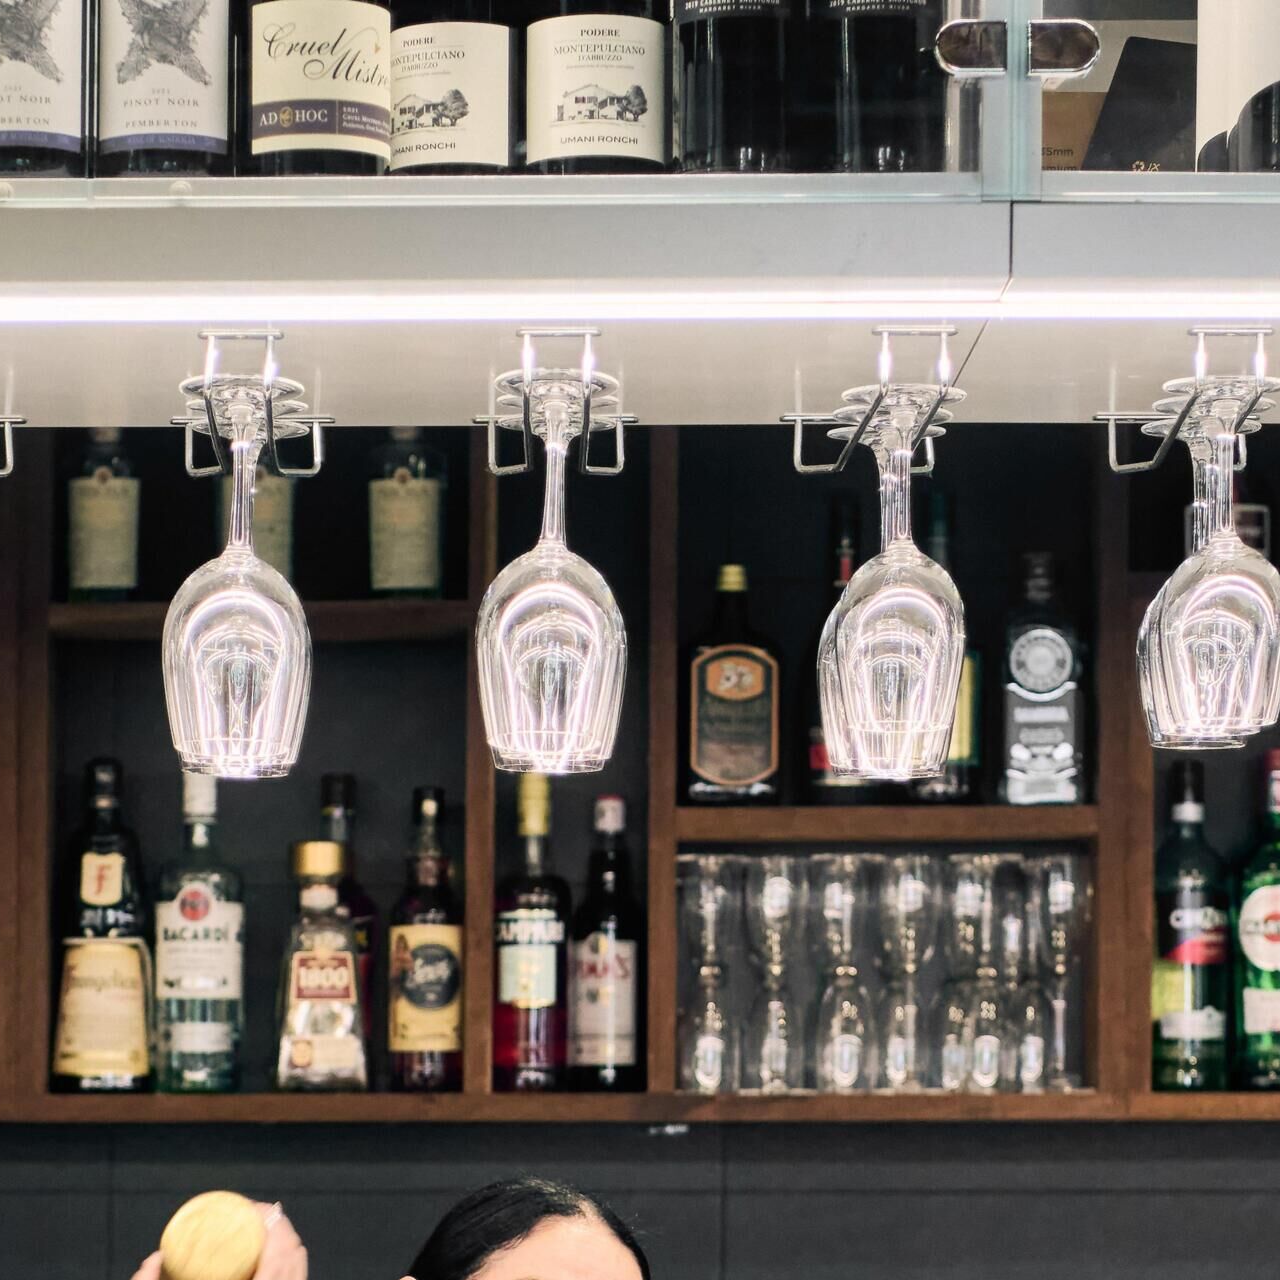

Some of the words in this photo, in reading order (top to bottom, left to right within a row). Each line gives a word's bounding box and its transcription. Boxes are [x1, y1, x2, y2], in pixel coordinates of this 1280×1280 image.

[579, 28, 621, 38] PODERE
[263, 23, 347, 63] Cruel
[402, 36, 434, 48] PODERE
[553, 43, 646, 57] MONTEPULCIANO
[391, 50, 466, 65] ONTEPULCIANO
[19, 95, 51, 104] NOIR
[123, 97, 160, 107] PINOT
[167, 97, 200, 107] NOIR
[260, 111, 278, 127] AD
[295, 108, 328, 124] HOC
[125, 119, 198, 129] PEMBERTON
[559, 135, 595, 145] UMANI
[596, 135, 639, 145] RONCHI
[394, 145, 414, 155] MANI
[415, 141, 457, 152] RONCHI
